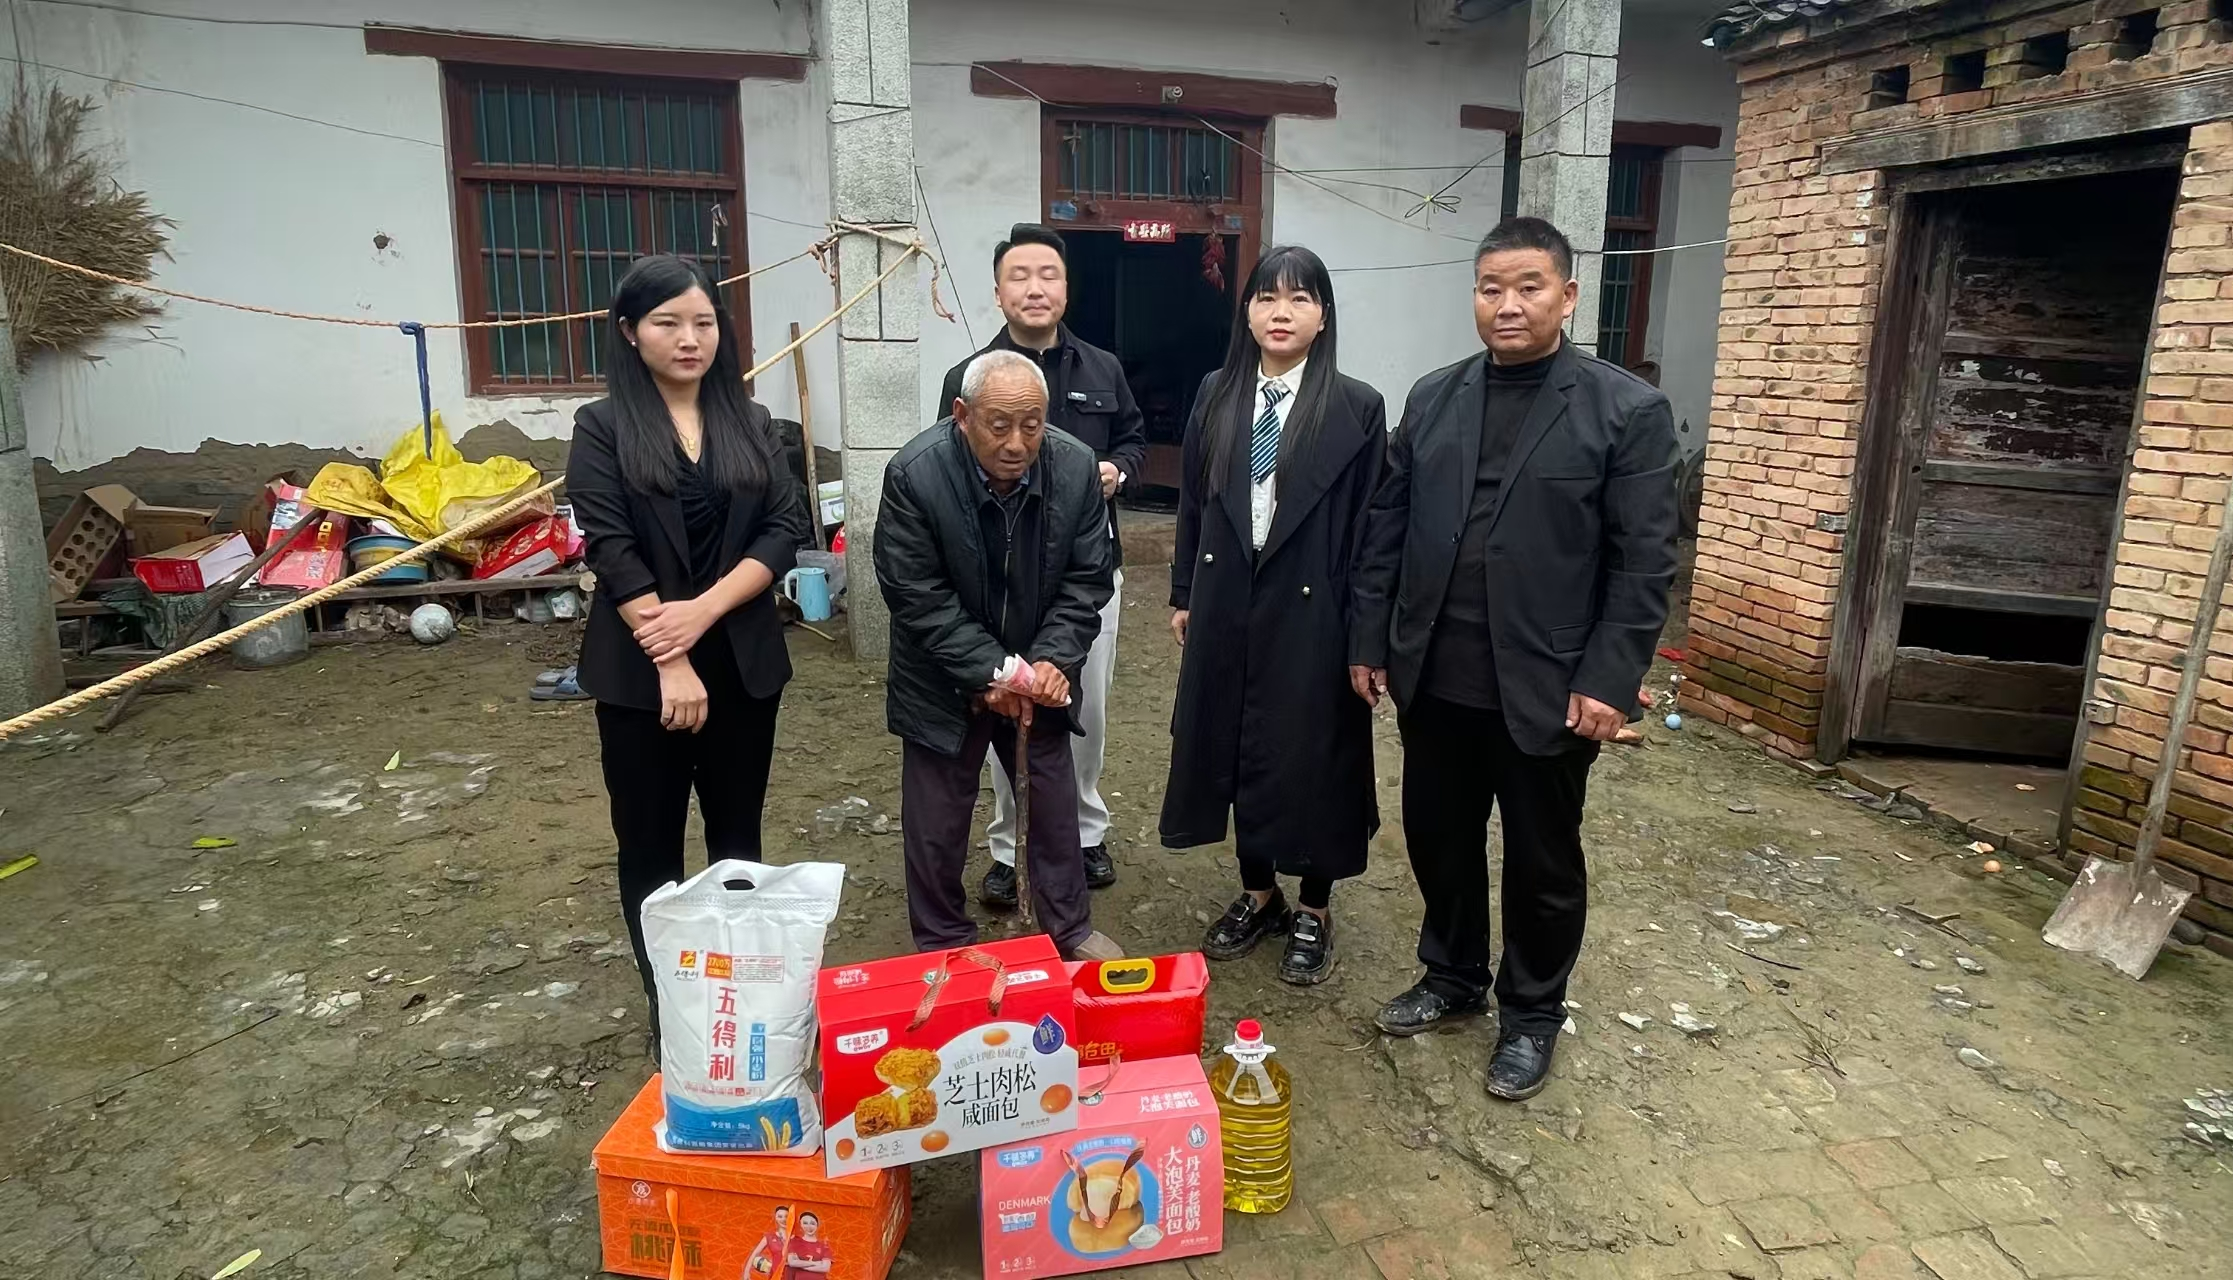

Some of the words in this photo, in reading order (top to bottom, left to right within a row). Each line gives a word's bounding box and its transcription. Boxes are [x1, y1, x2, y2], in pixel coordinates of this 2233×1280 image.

[708, 986, 738, 1081] 五得利
[943, 1061, 1036, 1107] 芝士肉松
[961, 1097, 1020, 1129] 咸面包
[998, 1195, 1051, 1211] DENMARK
[1164, 1146, 1184, 1236] 大泡芙面包
